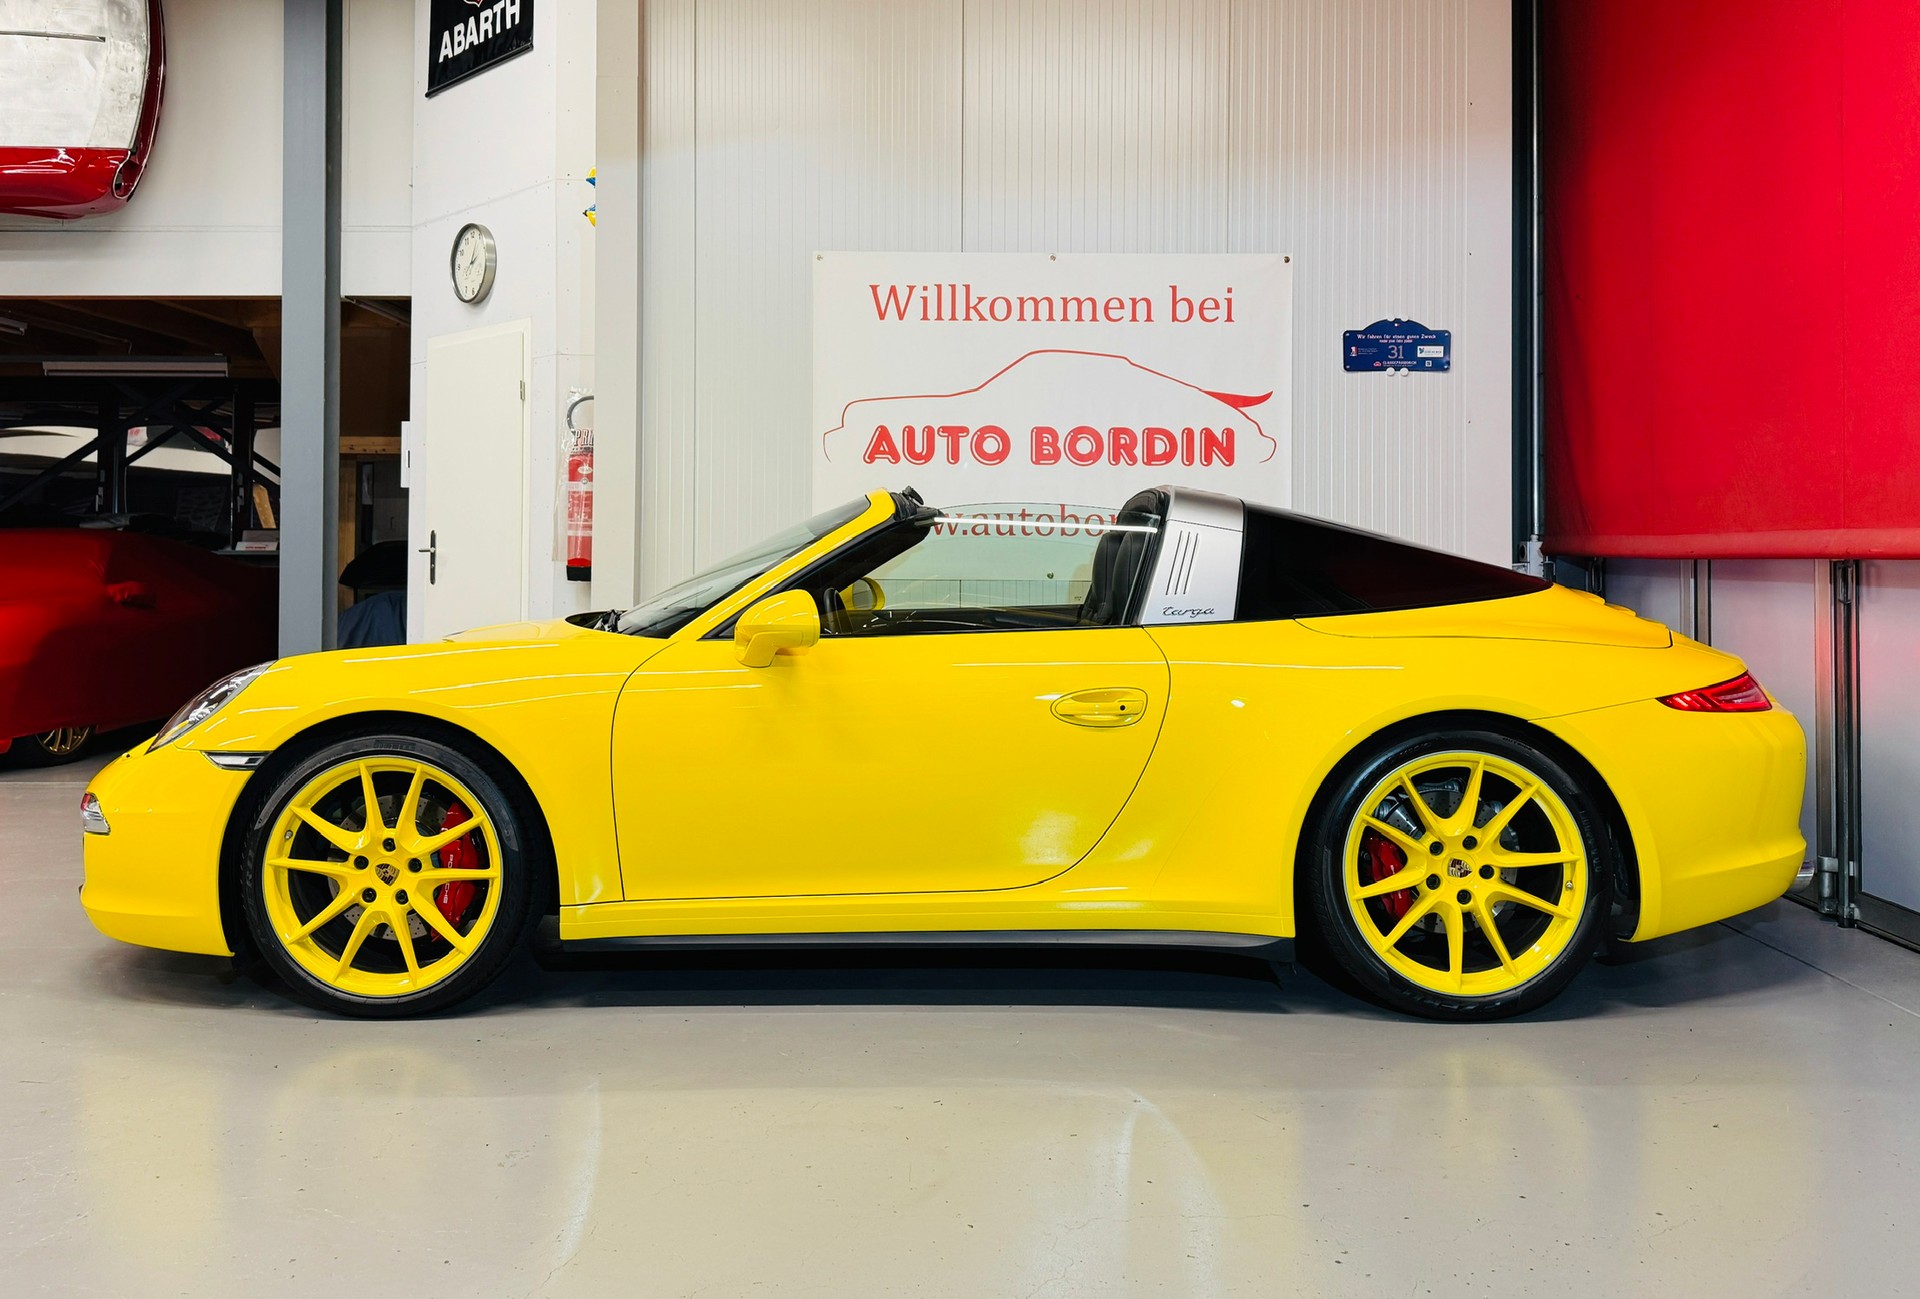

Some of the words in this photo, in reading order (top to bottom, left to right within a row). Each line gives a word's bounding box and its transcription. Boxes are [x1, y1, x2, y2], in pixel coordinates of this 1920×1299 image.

[438, 0, 520, 63] ABARTH
[870, 283, 1154, 323] Willkommen
[1170, 285, 1236, 323] bei
[1388, 345, 1404, 359] 31
[862, 424, 1012, 466] AUTO
[1030, 425, 1236, 467] BORDIN
[442, 854, 454, 904] POCHE
